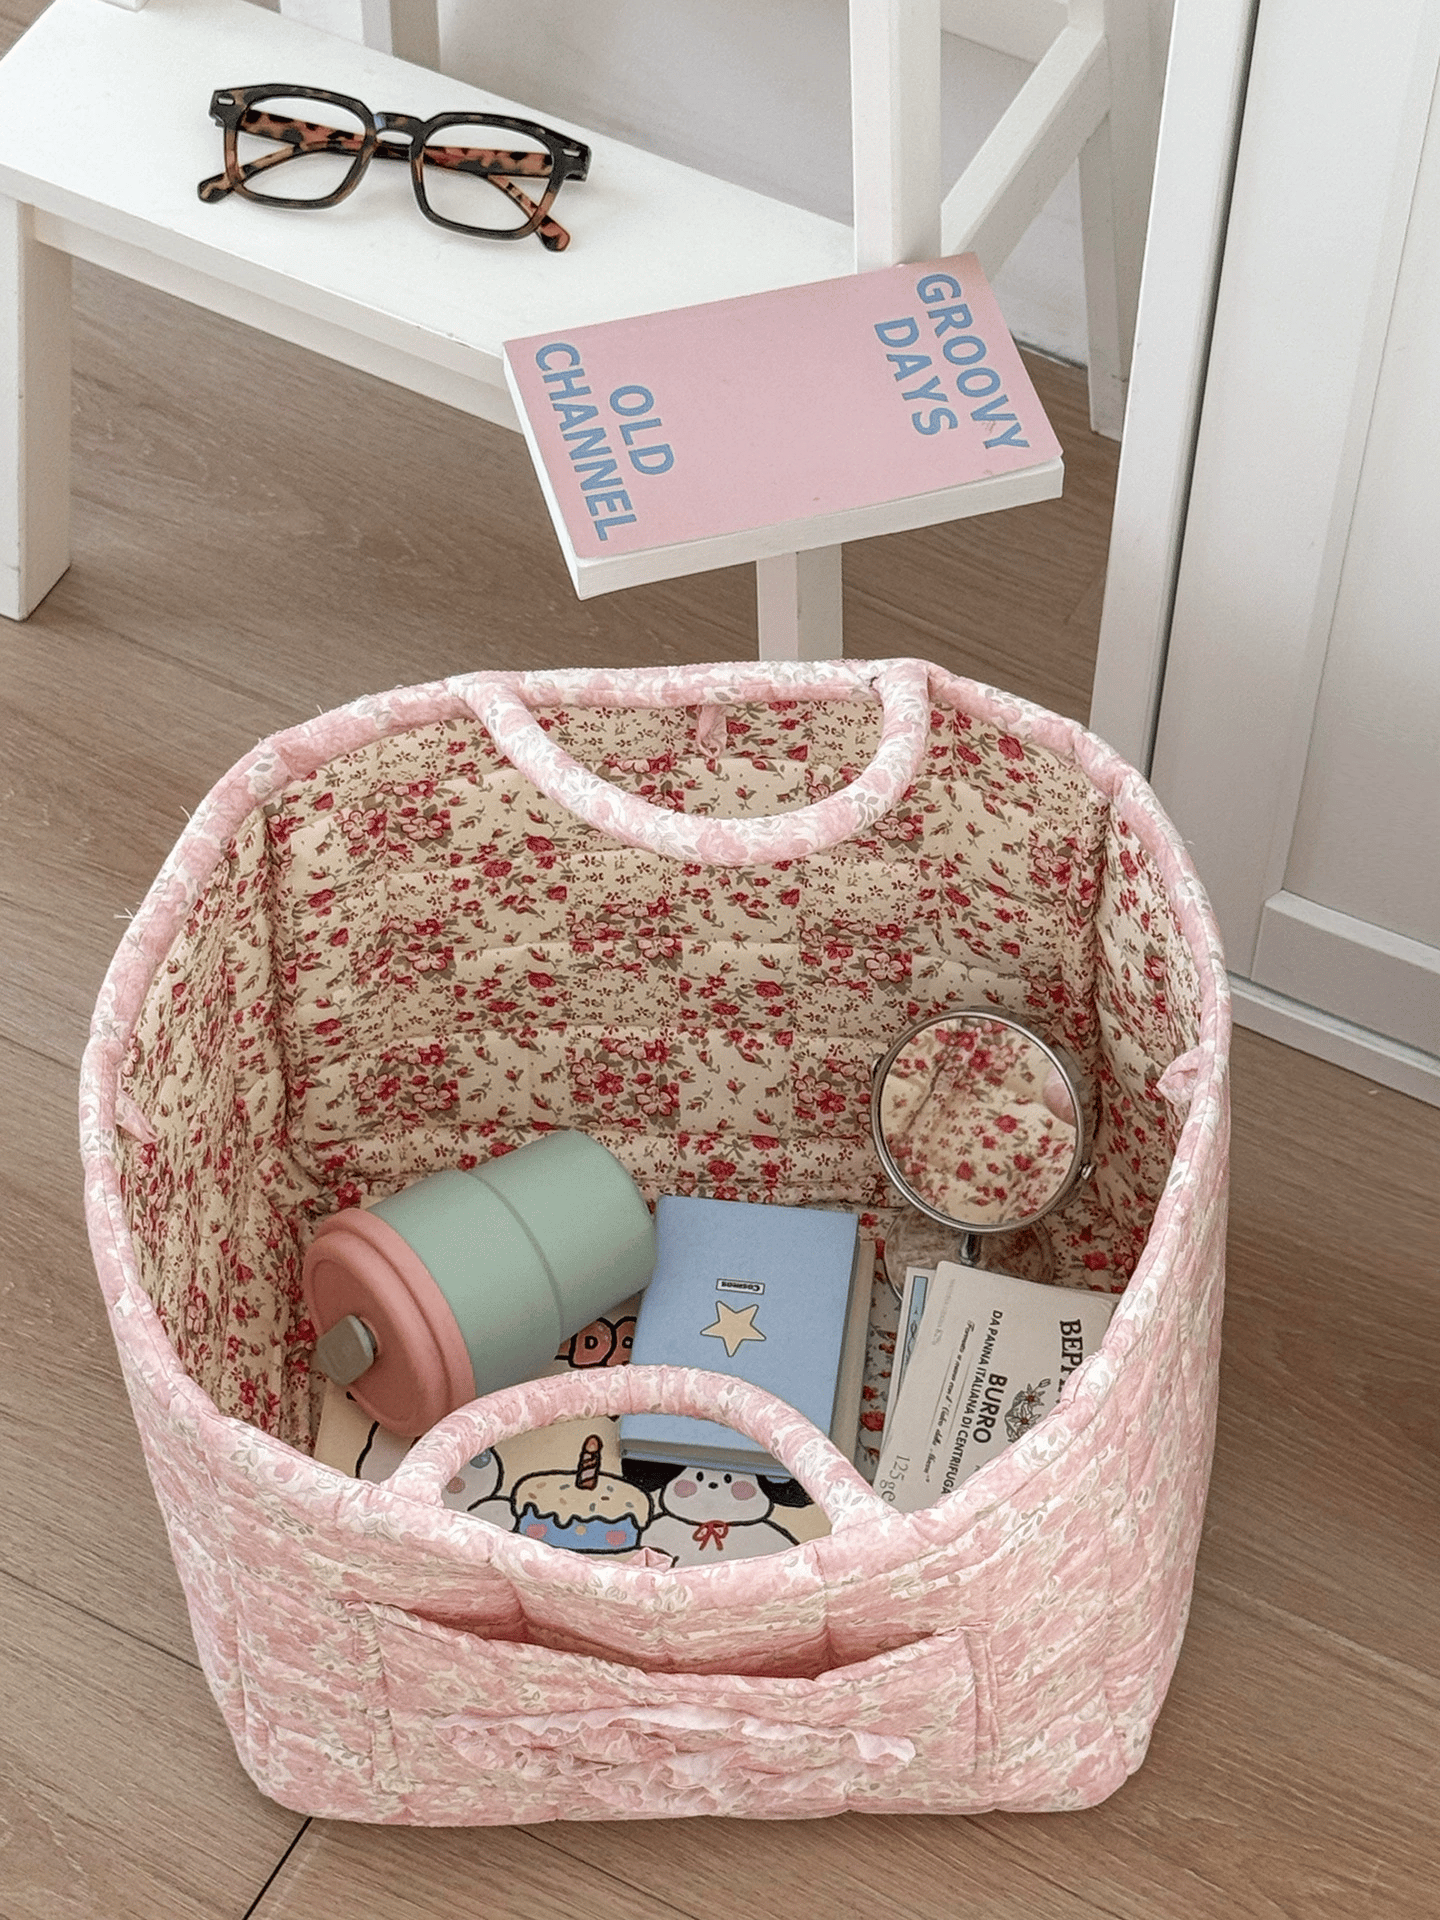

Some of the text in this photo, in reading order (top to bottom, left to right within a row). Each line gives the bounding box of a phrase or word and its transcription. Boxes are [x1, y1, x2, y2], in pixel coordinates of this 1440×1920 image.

[609, 385, 675, 475] OLD
[874, 317, 958, 435] DAYS
[917, 274, 1030, 450] GROOVY
[535, 342, 637, 541] CHANNEL
[940, 1309, 1004, 1495] DA PANNA ITALIANA DI CENTRIFUGA
[973, 1373, 1008, 1443] BURRO
